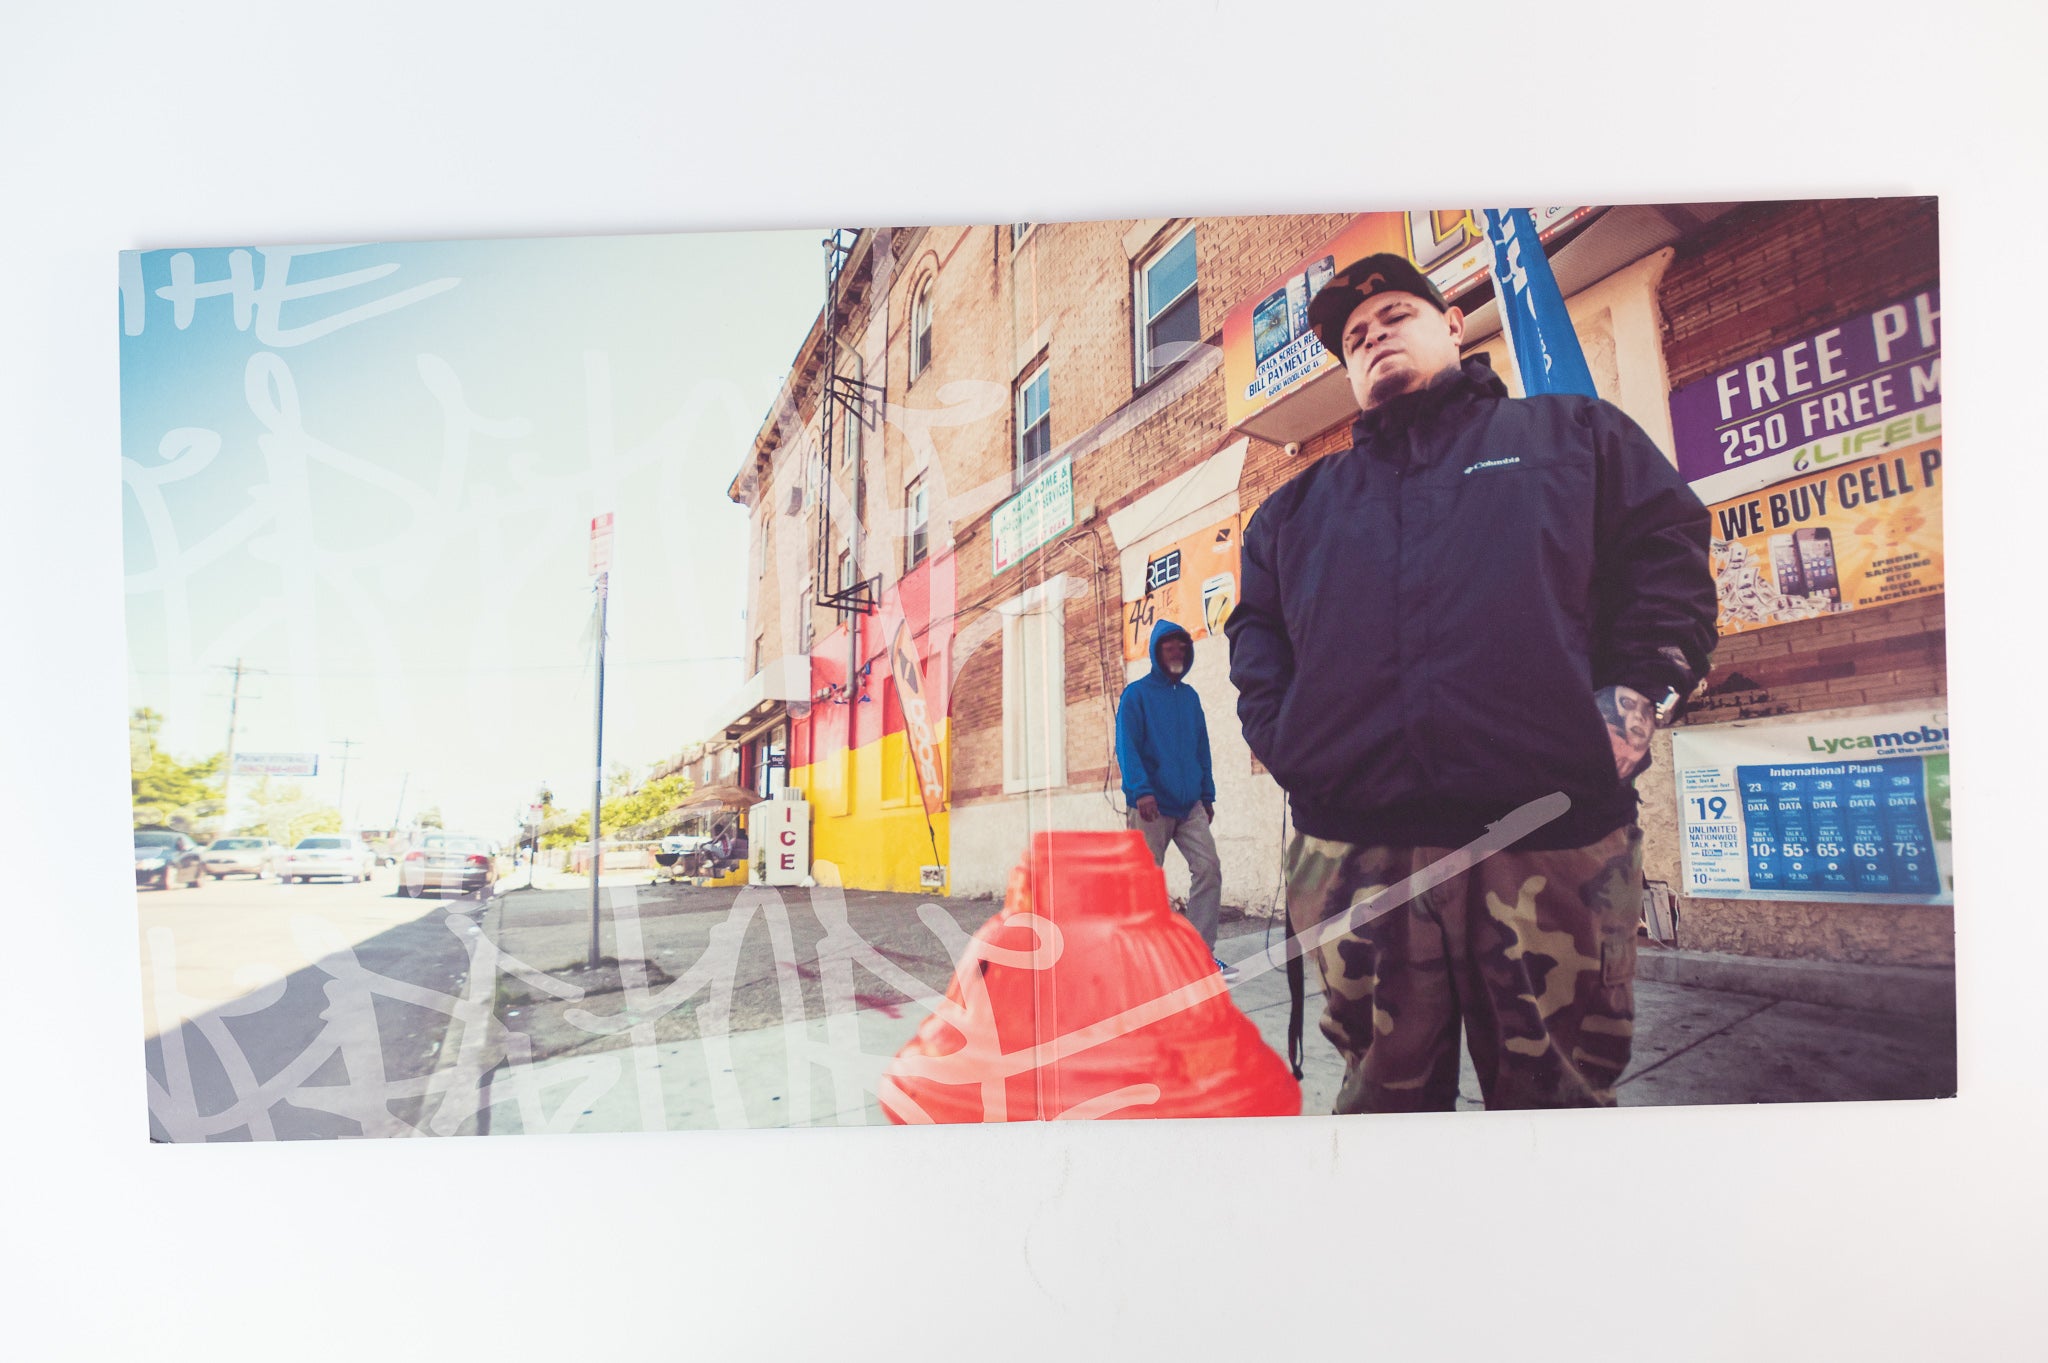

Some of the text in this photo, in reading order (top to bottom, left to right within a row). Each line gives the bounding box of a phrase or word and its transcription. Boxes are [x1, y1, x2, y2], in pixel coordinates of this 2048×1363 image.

[1258, 358, 1278, 376] CRACK
[1279, 341, 1302, 361] SCREEN
[1249, 378, 1266, 397] BILL
[1268, 349, 1307, 384] PAYMENT
[1716, 327, 1847, 421] FREE
[1719, 358, 1941, 466] 250 FREE M
[1814, 413, 1942, 463] LIFEL
[1035, 471, 1057, 497] HOME
[1719, 448, 1941, 541] WE BUY CELL P
[1865, 559, 1931, 578] SAMSUNG
[1770, 764, 1884, 776] International Plans
[1748, 803, 1769, 811] DATA
[1779, 802, 1802, 810] DATA
[1813, 800, 1838, 809] DATA
[1849, 799, 1876, 808] DATA
[1888, 798, 1917, 806] DATA
[780, 807, 796, 870] ICE
[1689, 825, 1737, 834] UNLIMITED
[1689, 833, 1737, 841] NATIONWIDE
